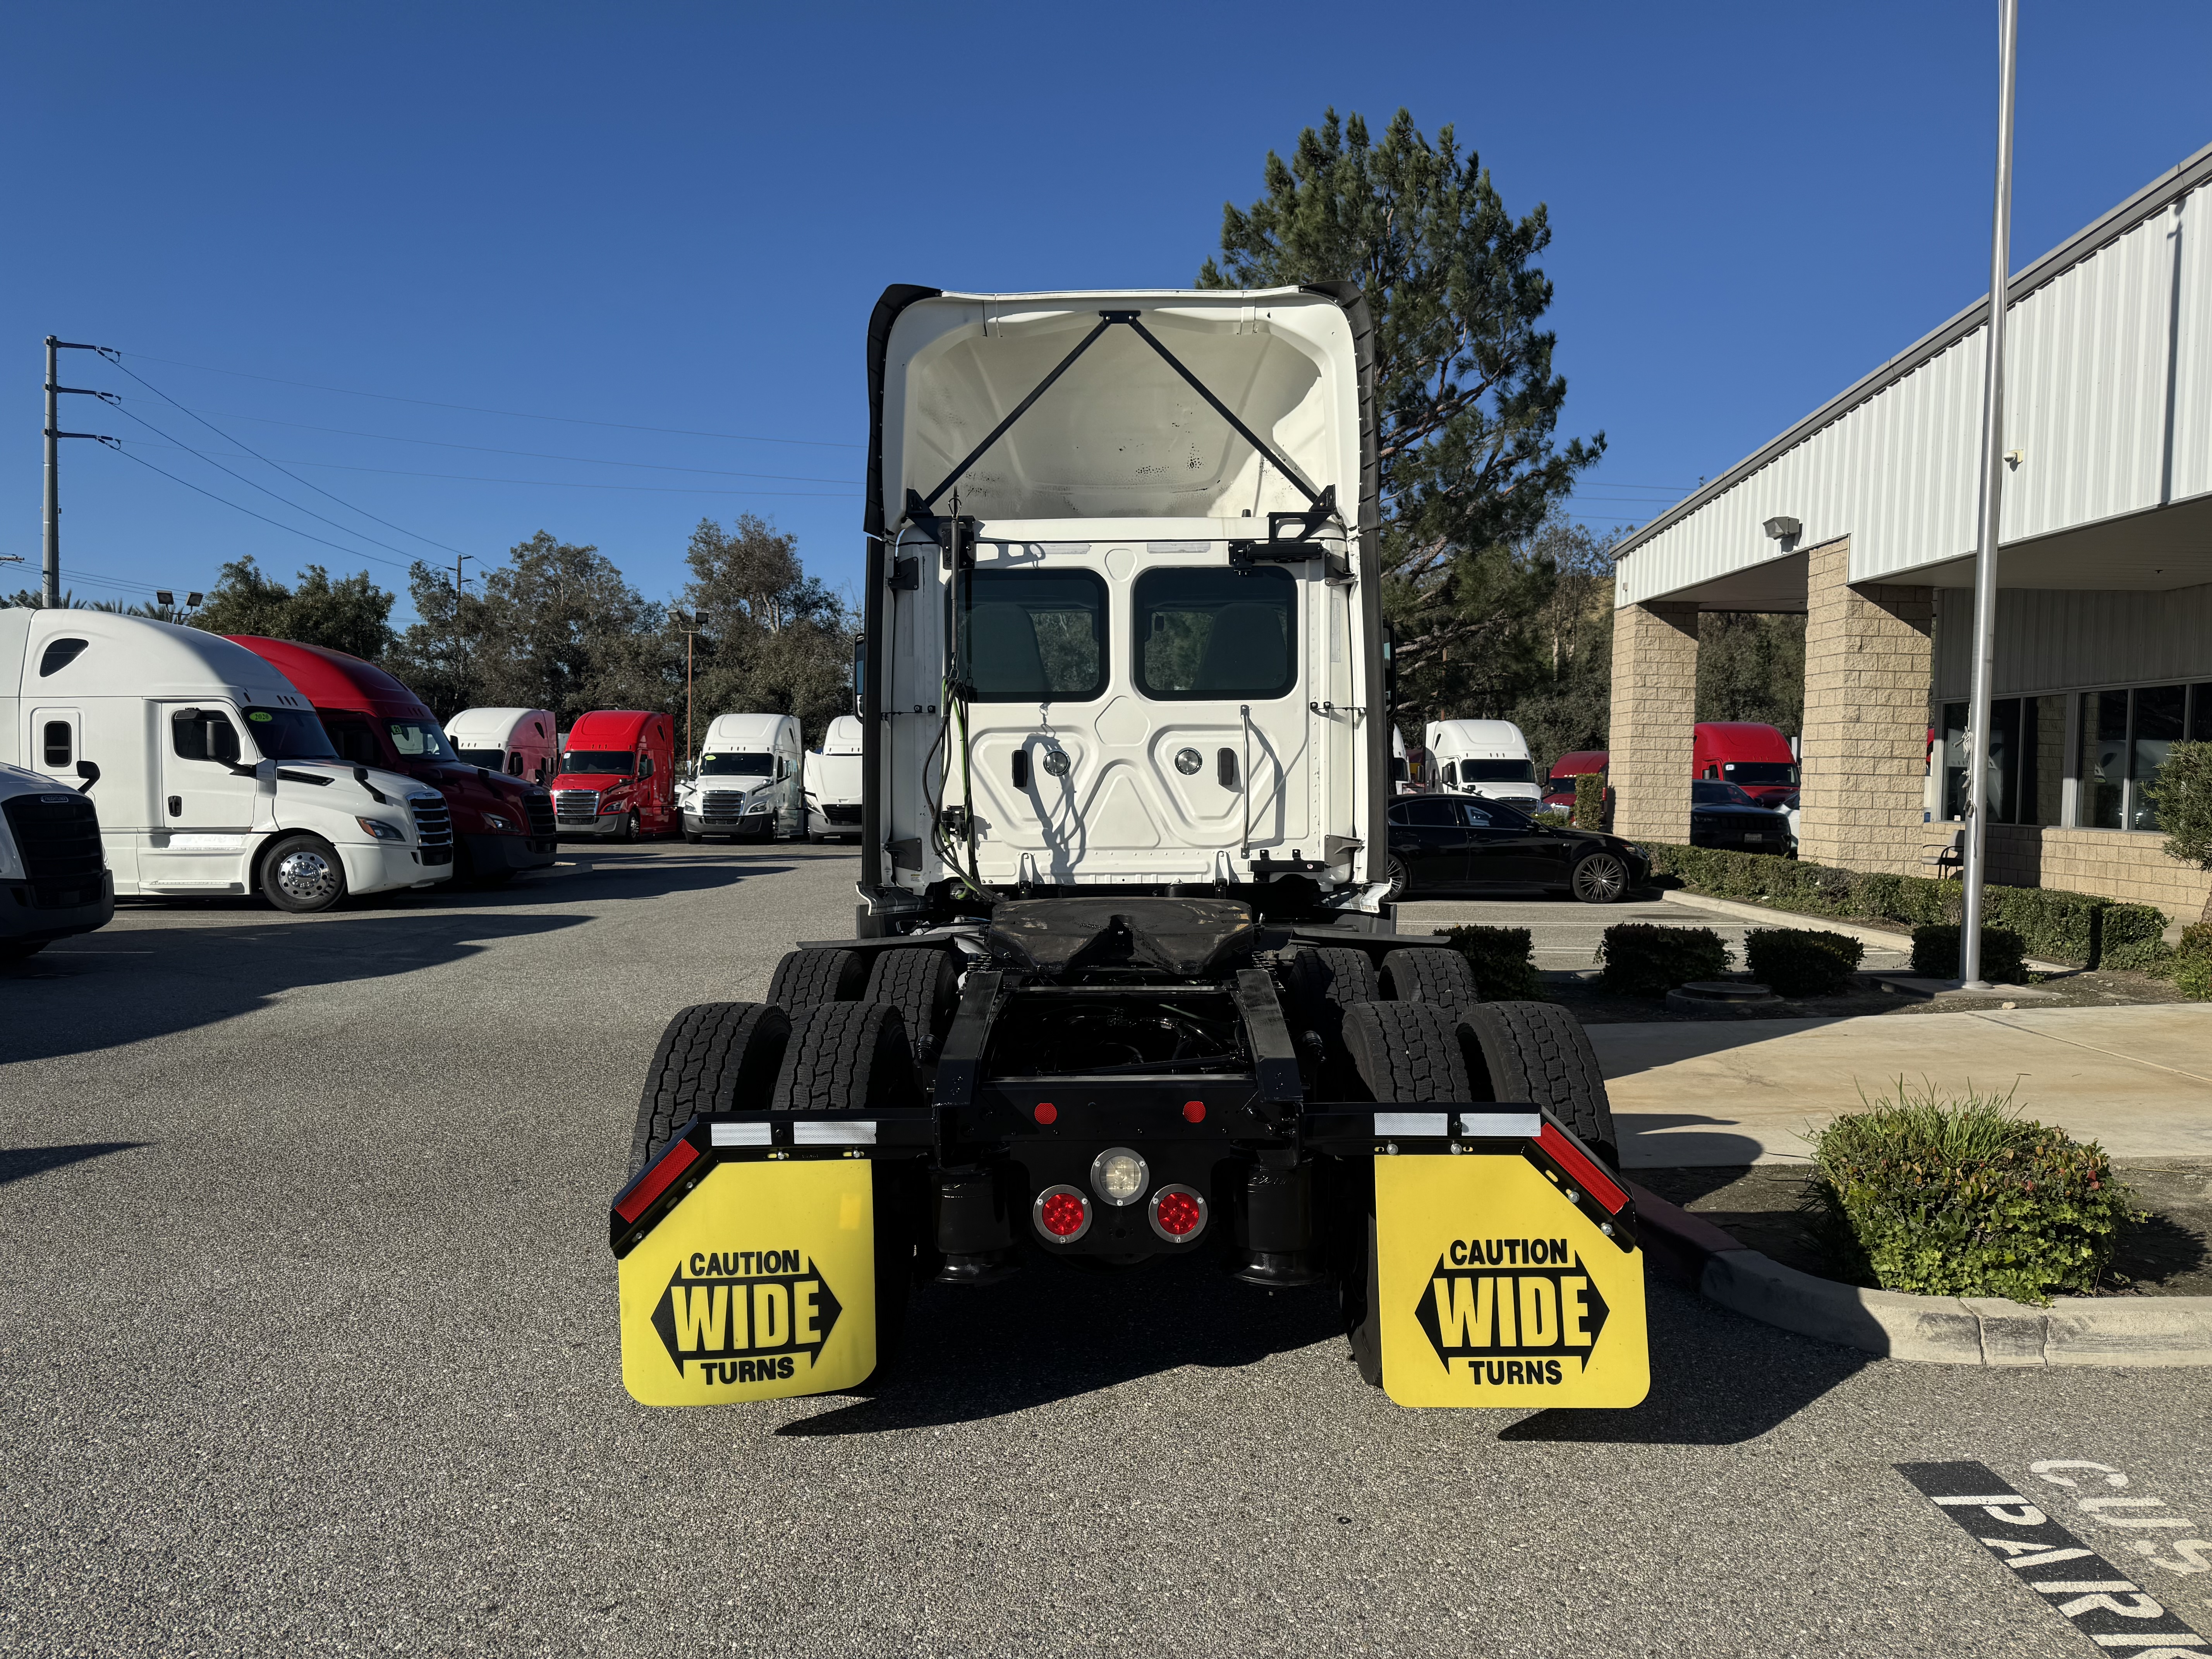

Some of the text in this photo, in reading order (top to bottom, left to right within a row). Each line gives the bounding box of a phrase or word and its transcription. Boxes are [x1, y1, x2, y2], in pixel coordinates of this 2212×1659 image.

[689, 1249, 799, 1276] CAUTION
[1449, 1238, 1568, 1265] CAUTION
[671, 1280, 821, 1352] WIDE
[1433, 1276, 1592, 1348] WIDE
[700, 1357, 794, 1385] TURNS
[1468, 1360, 1562, 1385] TURNS
[2030, 1460, 2212, 1609] CUS
